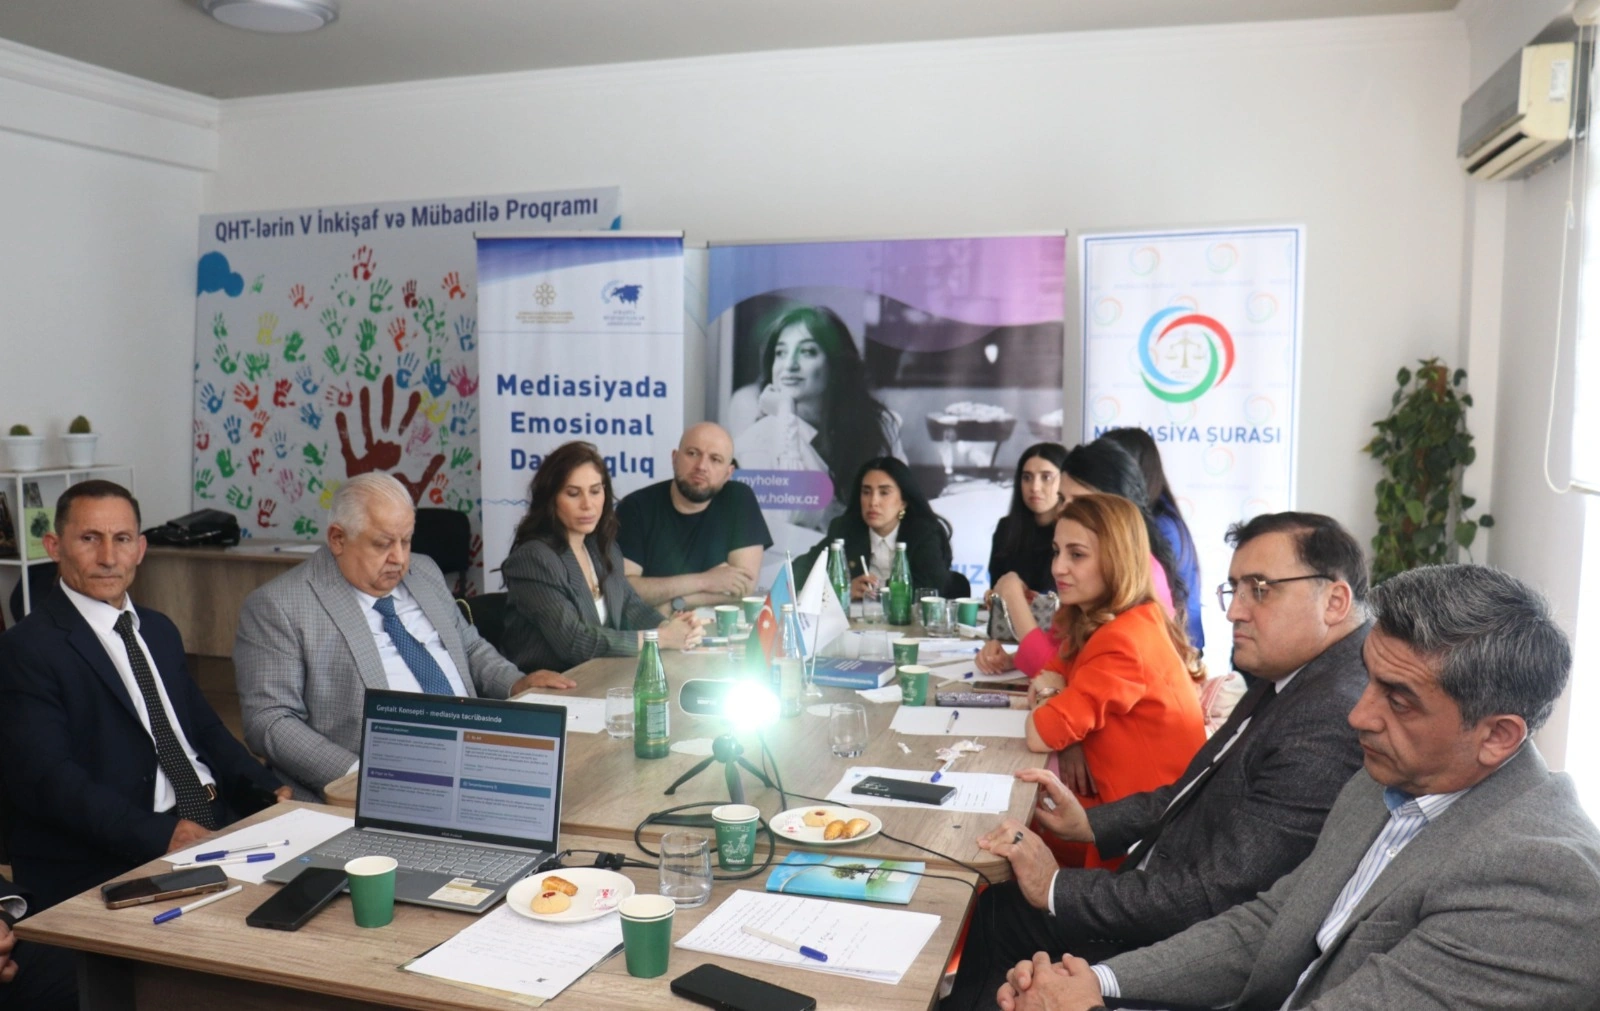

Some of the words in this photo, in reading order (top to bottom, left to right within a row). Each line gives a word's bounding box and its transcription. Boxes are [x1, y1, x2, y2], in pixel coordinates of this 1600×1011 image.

[215, 216, 295, 243] QHT-lərin
[299, 214, 312, 235] V
[317, 208, 380, 237] İnkişaf
[384, 211, 406, 229] və
[411, 200, 500, 227] Mübadilə
[505, 197, 599, 223] Proqramı
[496, 373, 668, 402] Mediasiyada
[510, 411, 655, 436] Emosional
[1093, 422, 1201, 443] MASİYA
[1206, 426, 1281, 447] ŞURASI
[510, 448, 655, 479] Daqlıq
[756, 492, 820, 505] w.holex.az
